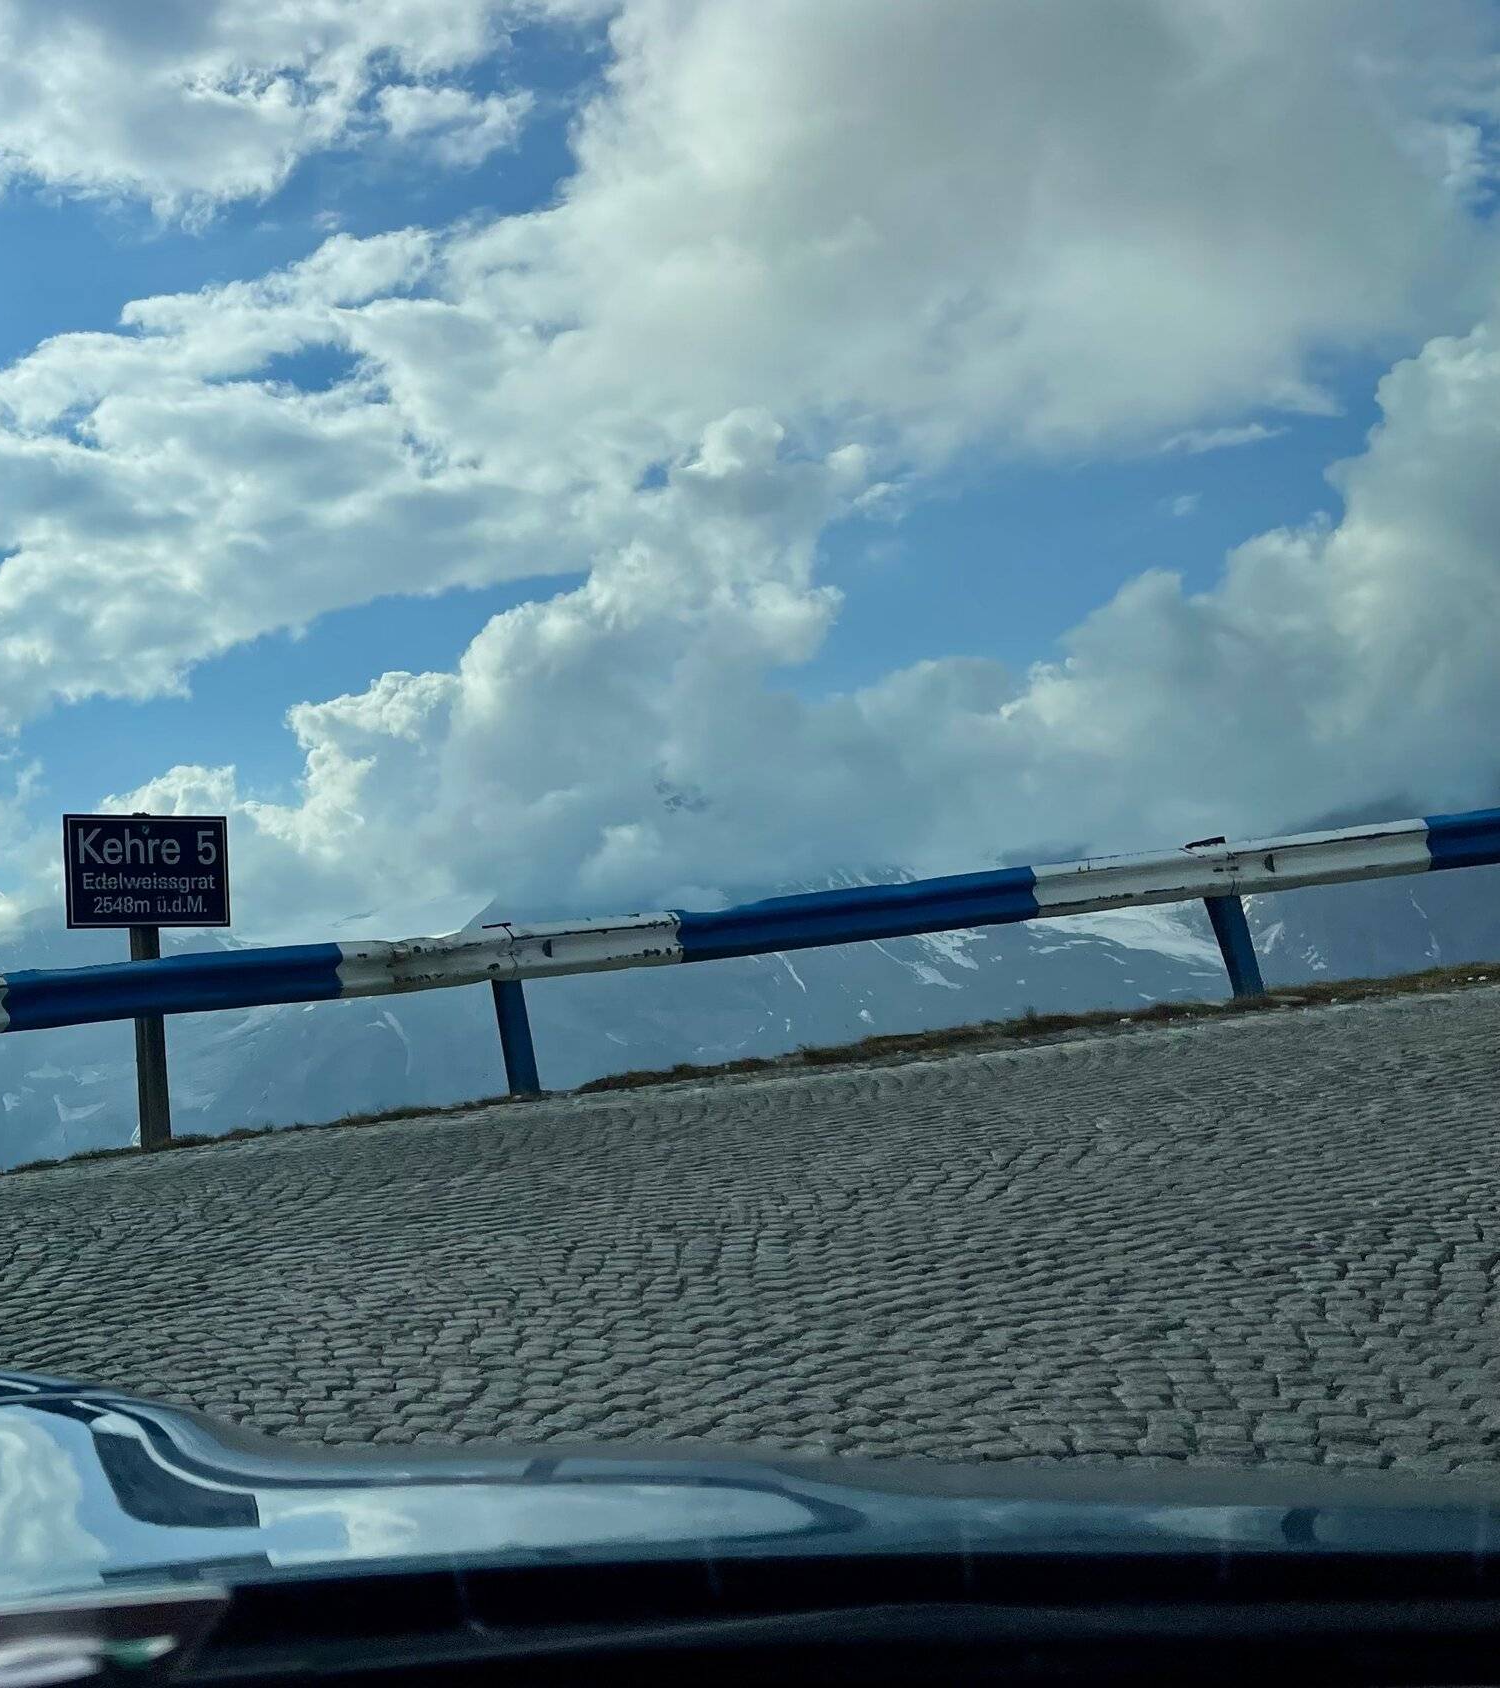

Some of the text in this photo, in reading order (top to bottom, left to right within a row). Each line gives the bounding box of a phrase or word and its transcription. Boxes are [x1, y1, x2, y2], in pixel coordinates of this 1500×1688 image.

[77, 828, 217, 865] Kehre 5
[82, 872, 216, 893] Edelweissgrat
[93, 895, 208, 914] 2548m ü.d.M.
